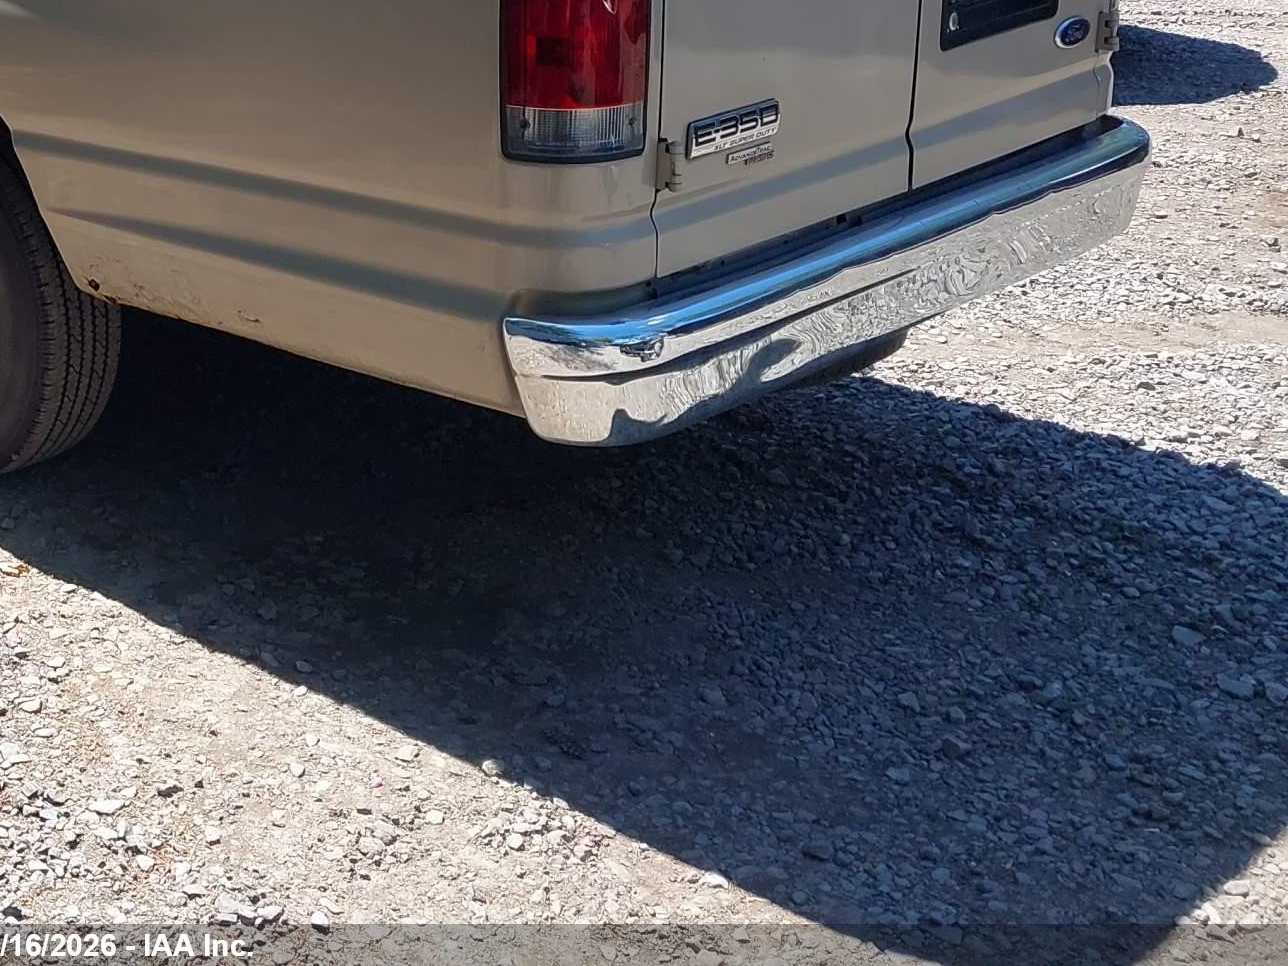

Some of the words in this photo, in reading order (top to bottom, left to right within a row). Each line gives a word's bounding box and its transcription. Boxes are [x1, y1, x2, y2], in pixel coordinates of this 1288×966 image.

[694, 100, 779, 147] E-350
[713, 141, 728, 151] XLT
[729, 133, 755, 146] SUPER
[756, 127, 777, 139] DUTY
